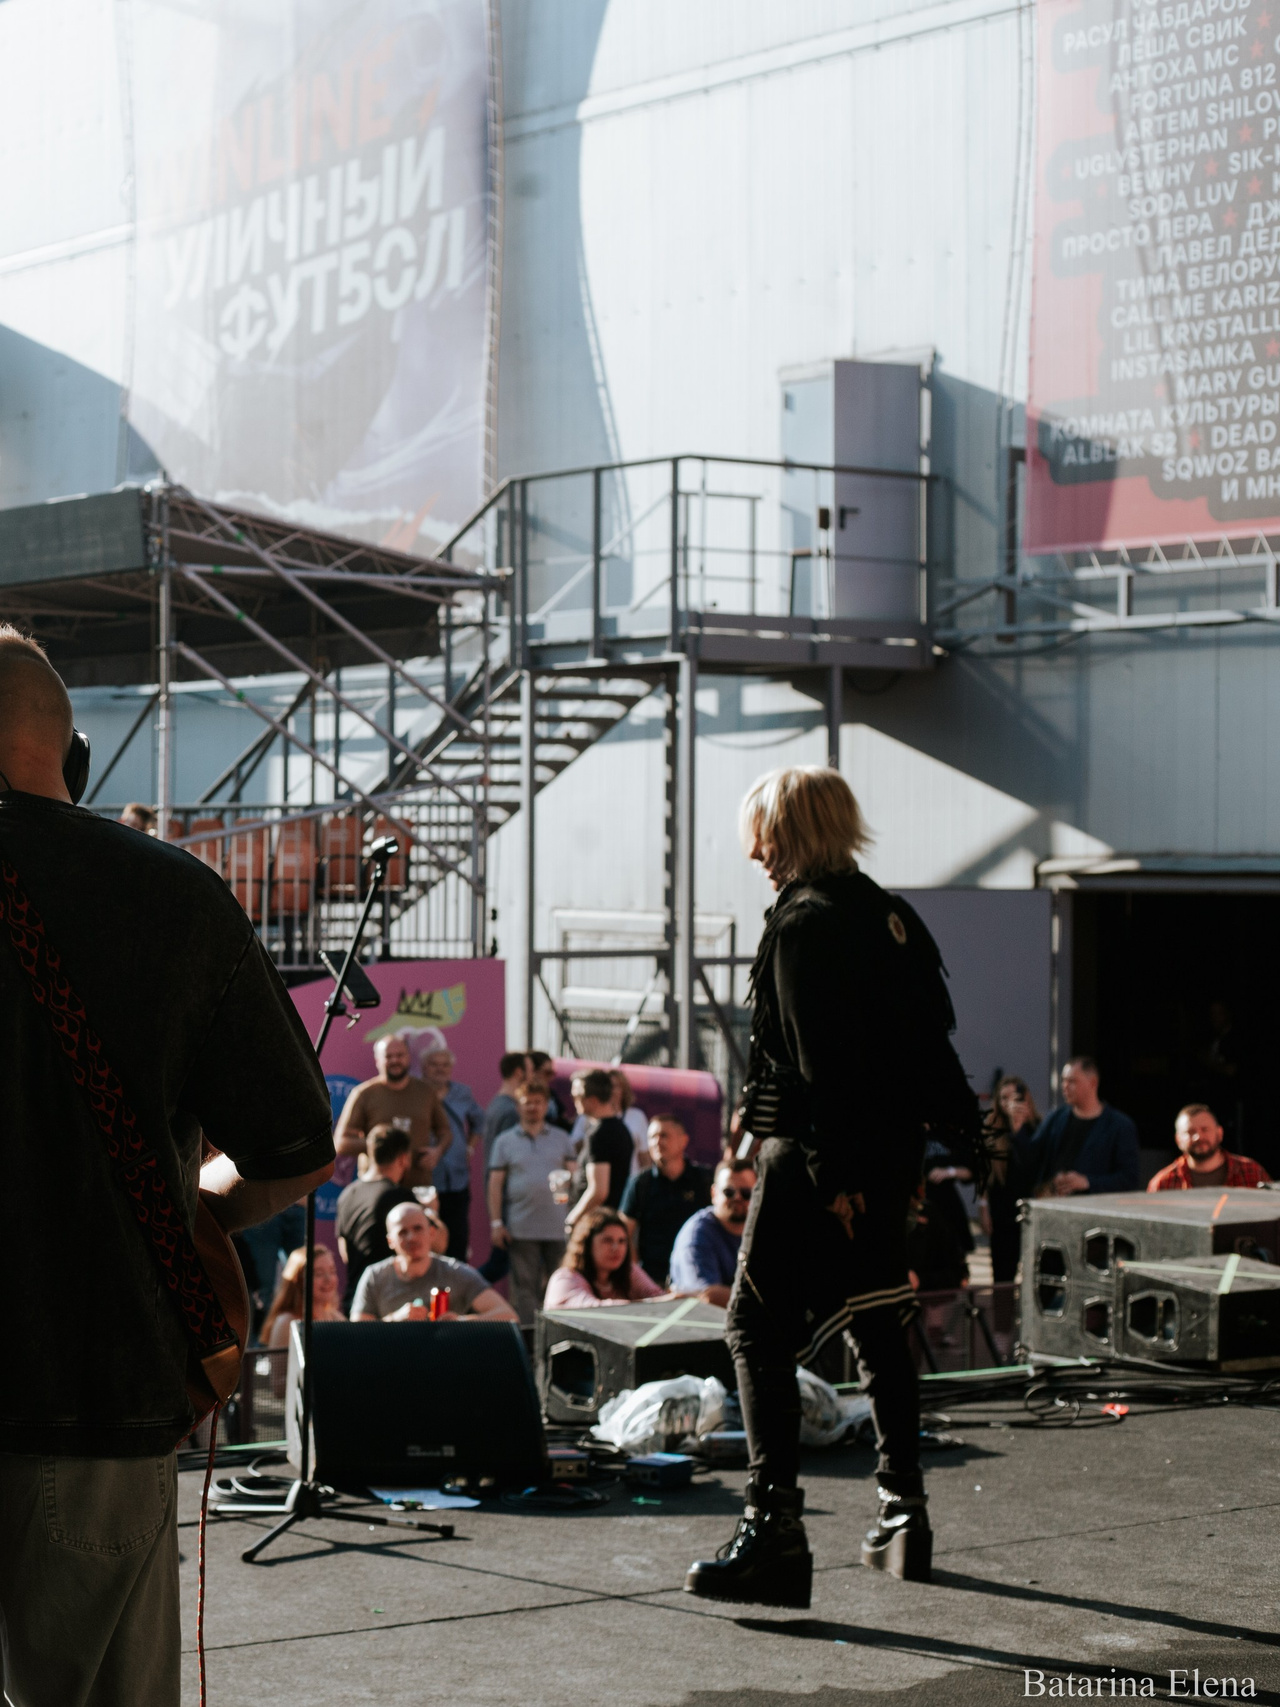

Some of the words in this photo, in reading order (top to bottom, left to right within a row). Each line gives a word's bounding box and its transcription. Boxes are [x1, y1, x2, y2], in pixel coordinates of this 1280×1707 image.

[1064, 20, 1128, 53] РАСУЛ
[1118, 34, 1180, 67] ЛЁША
[1186, 16, 1248, 49] СВИК
[1109, 56, 1198, 93] АНТОХА
[1131, 74, 1234, 115] FORTUNA
[1240, 64, 1277, 91] 812
[1125, 108, 1200, 144] ARTEM
[1076, 128, 1229, 180] UGLYSTEPHAN
[1119, 162, 1196, 198] BEWHY
[1129, 190, 1189, 221] SODA
[1195, 180, 1239, 209] LUV
[1063, 224, 1152, 259] ПРОСТО
[1157, 213, 1214, 244] ЛЕРА
[1157, 236, 1232, 269] ПАВЕЛ
[1116, 272, 1182, 301] ТИМА
[1187, 255, 1280, 292] БЕЛОРУ
[1111, 303, 1167, 330] CALL
[1173, 294, 1207, 320] ME
[1212, 282, 1280, 314] KARIZ
[1111, 341, 1257, 382] INSTASAMKA
[1124, 331, 1156, 355] LIL
[1176, 370, 1242, 400] MARY
[1050, 410, 1156, 442] КОМНАТА
[1161, 393, 1280, 429] КУЛЬТУРЫ
[1063, 437, 1146, 466] ALBLAK
[1151, 432, 1178, 458] 52
[1211, 421, 1277, 450] DEAD
[1163, 451, 1249, 482] SQWOZ
[1222, 478, 1239, 504] И
